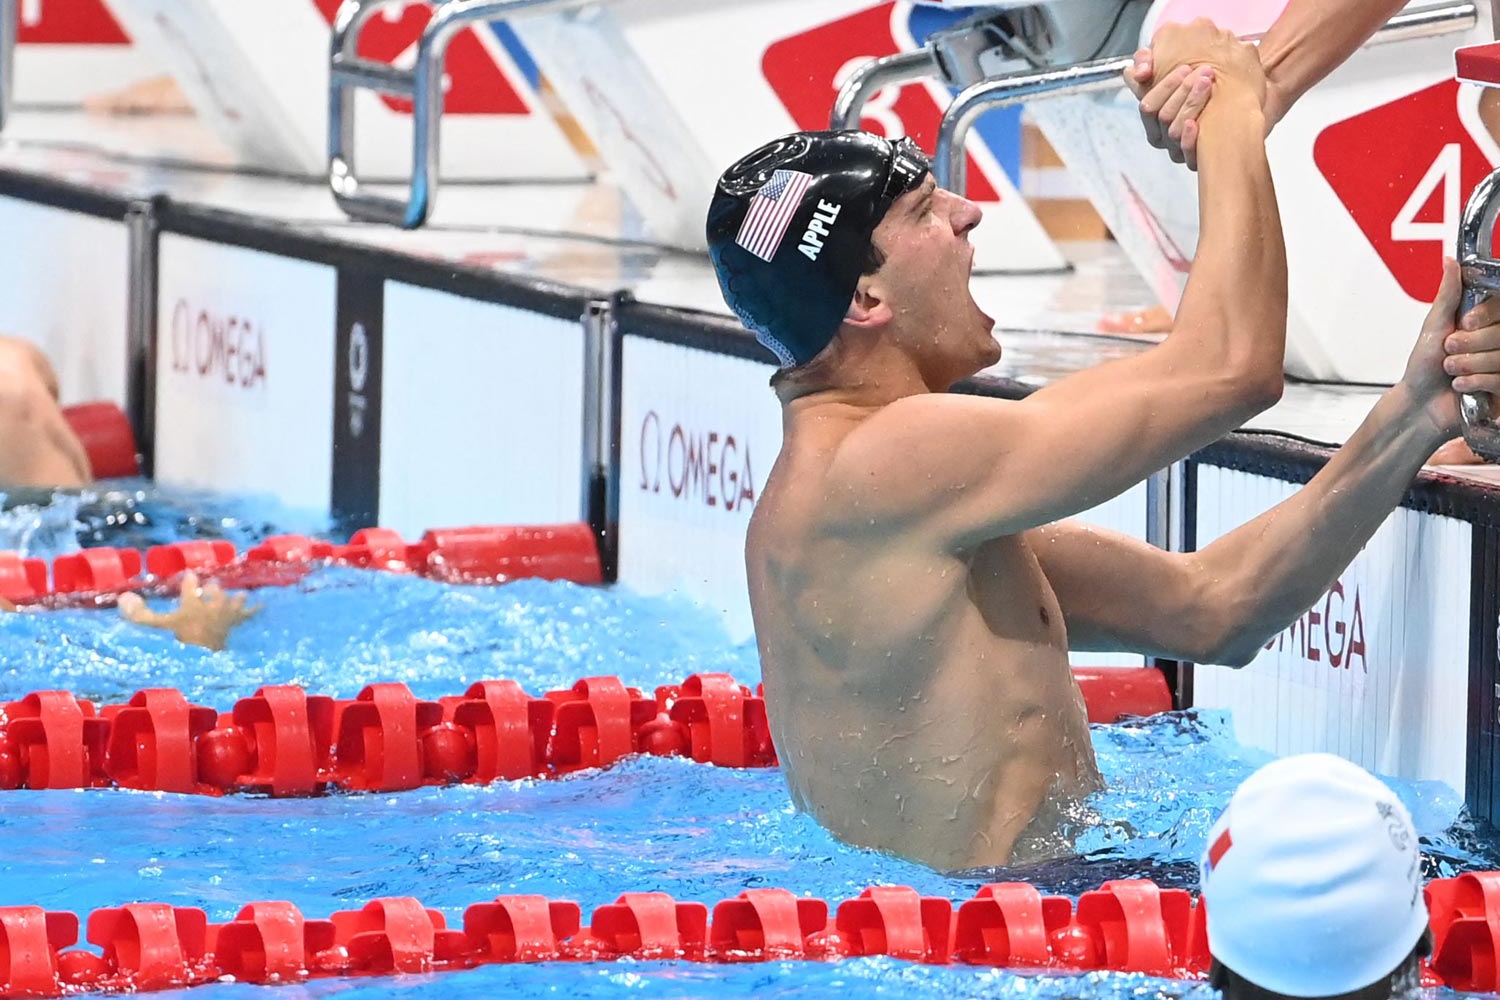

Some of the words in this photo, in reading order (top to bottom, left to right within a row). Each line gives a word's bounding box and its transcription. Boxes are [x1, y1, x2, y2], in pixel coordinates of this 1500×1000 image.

[797, 198, 842, 262] APPLE
[1391, 143, 1461, 258] 4
[196, 309, 267, 389] OMEGA
[667, 422, 755, 512] OMEGA
